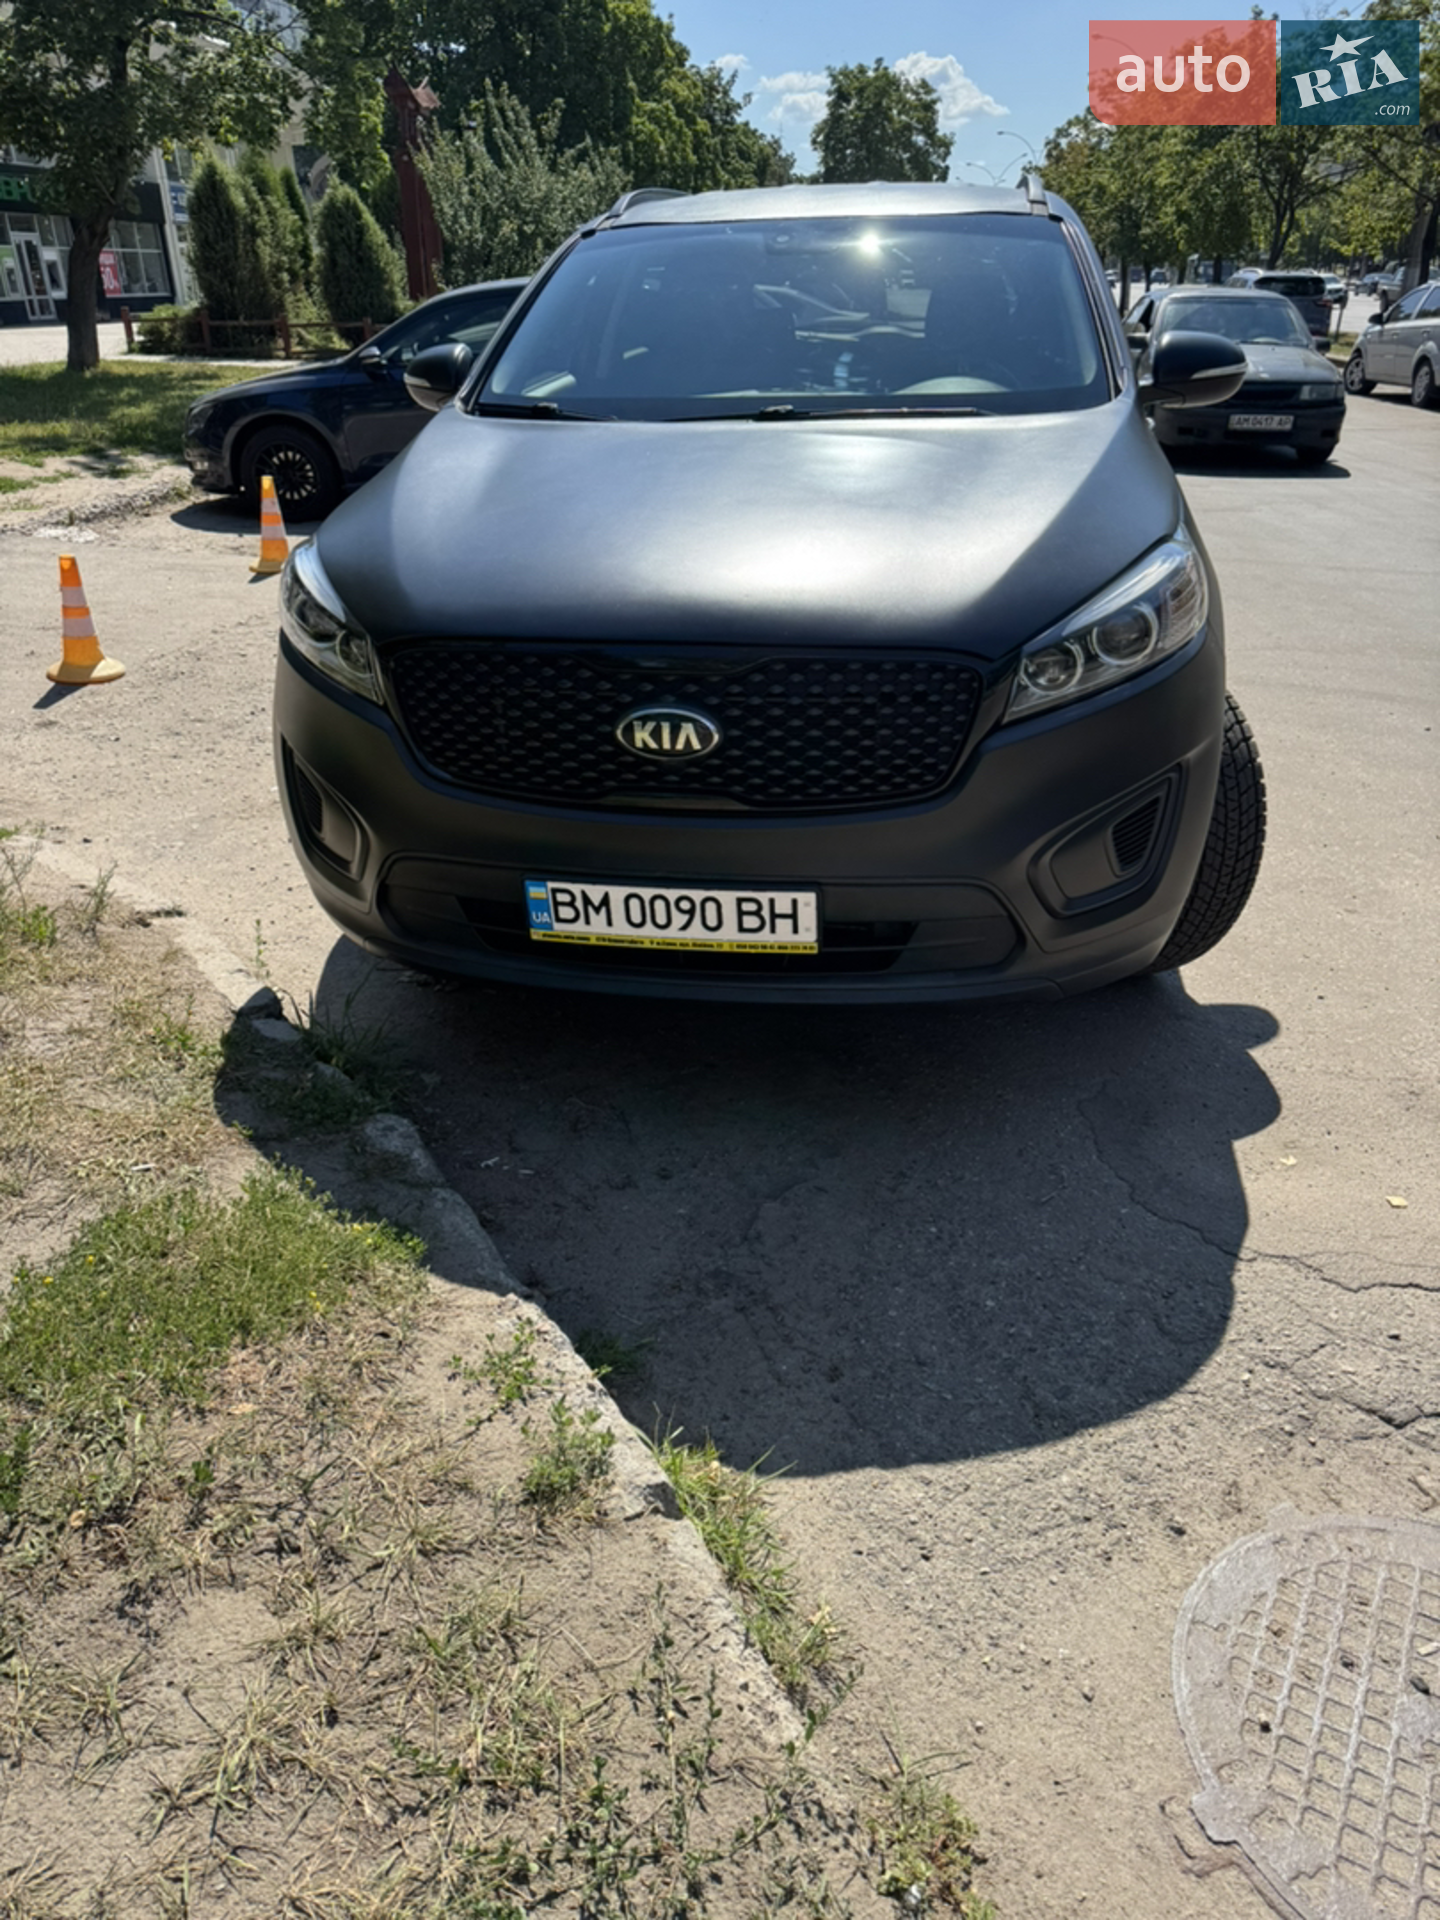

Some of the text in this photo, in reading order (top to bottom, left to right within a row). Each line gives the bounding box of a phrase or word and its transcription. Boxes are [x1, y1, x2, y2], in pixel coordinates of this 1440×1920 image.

[633, 721, 702, 750] KIA
[532, 911, 551, 924] UA
[550, 888, 799, 935] BM 0090 BH
